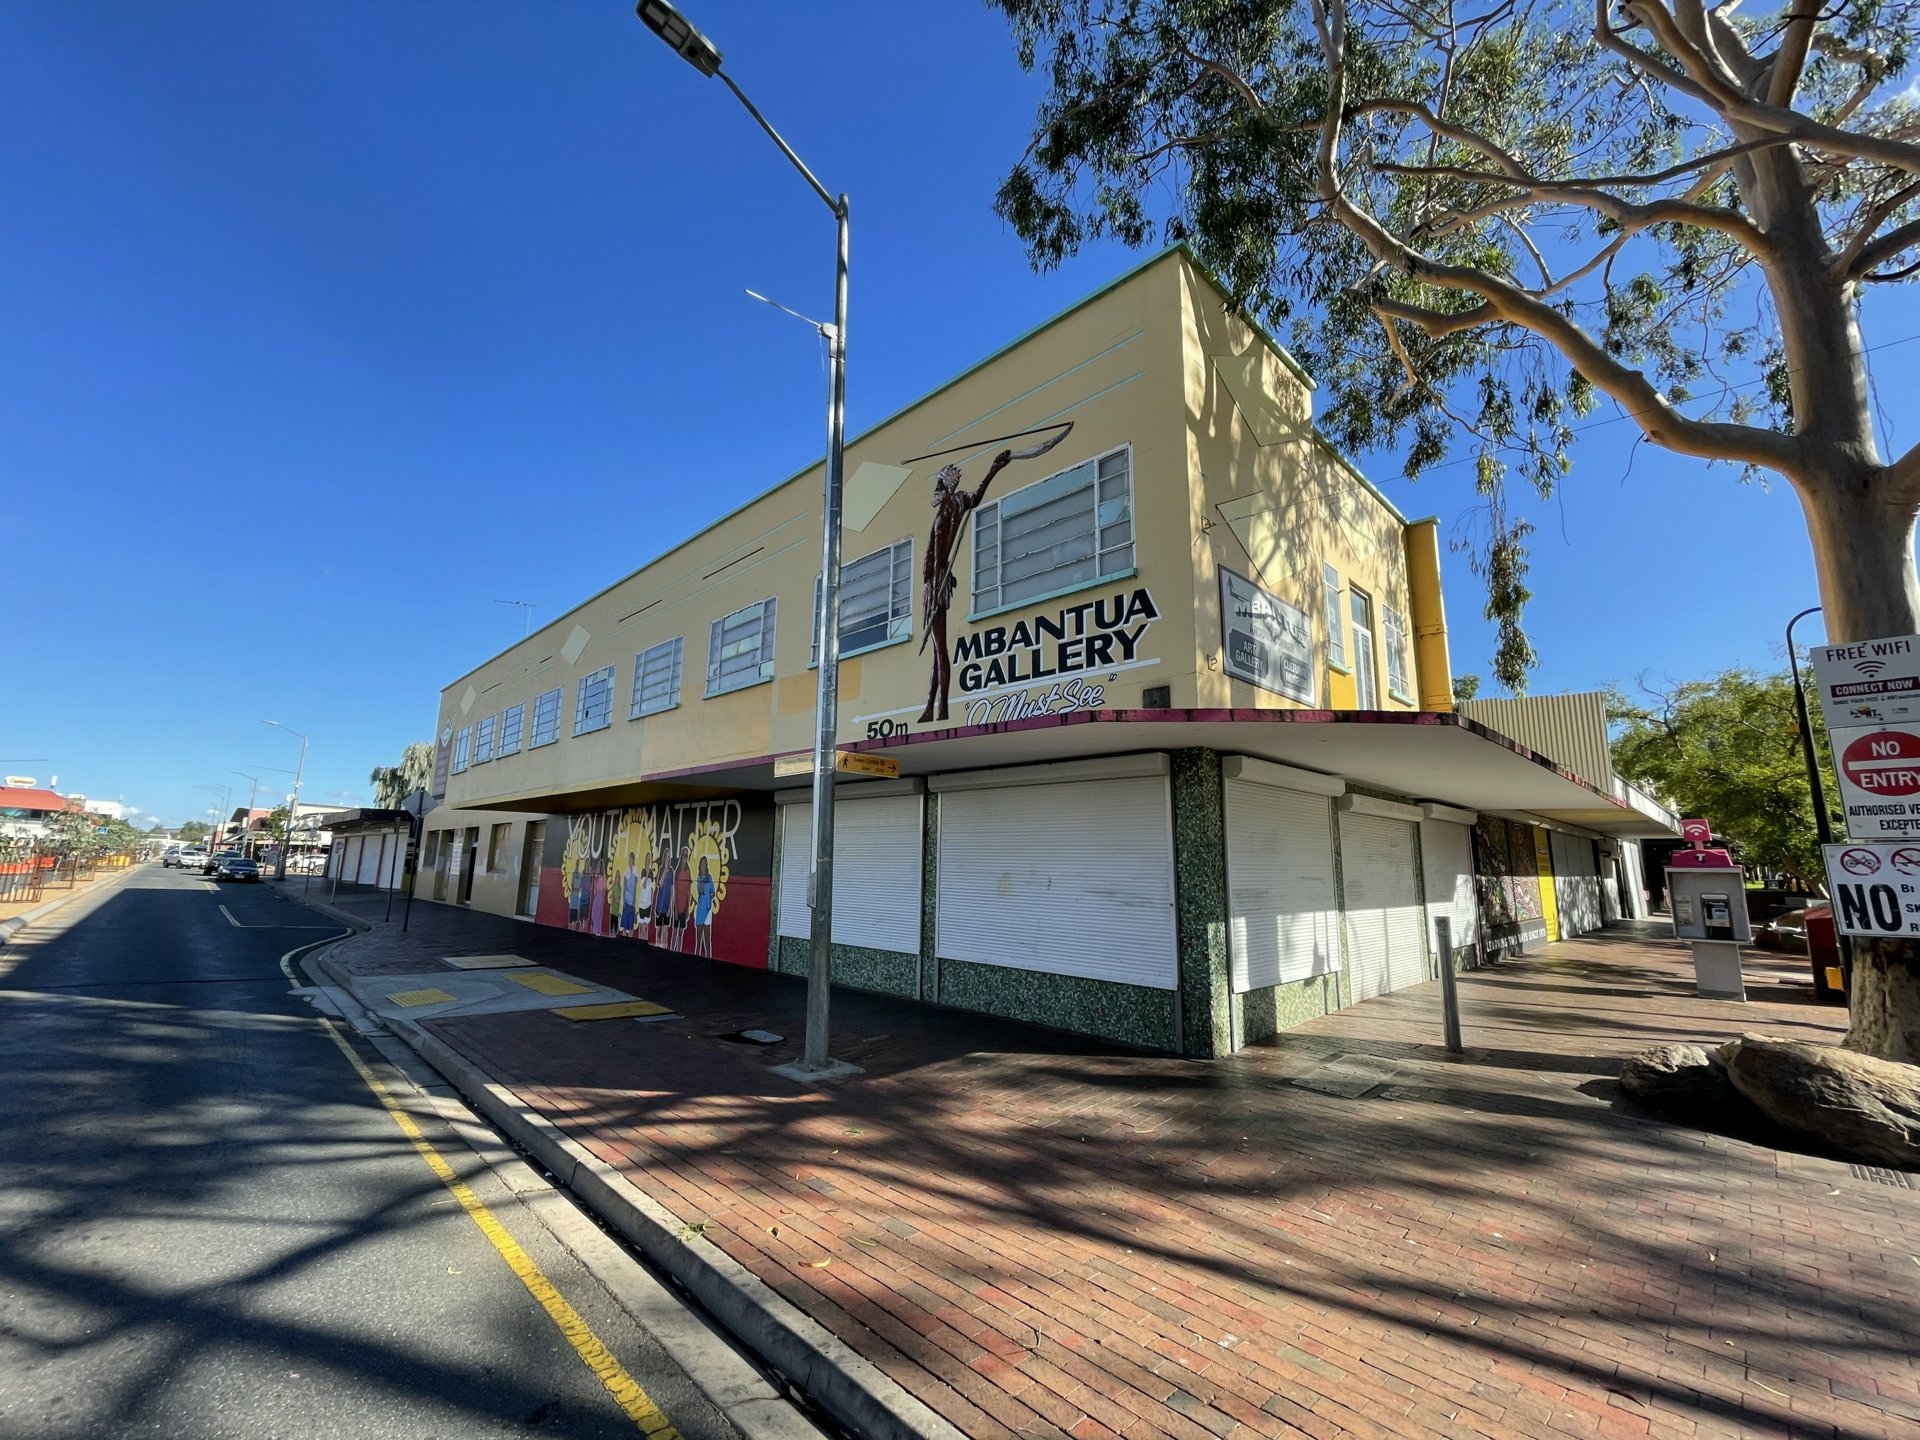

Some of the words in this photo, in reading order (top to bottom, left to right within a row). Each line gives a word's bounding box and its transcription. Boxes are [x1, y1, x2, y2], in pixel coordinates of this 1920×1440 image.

[953, 588, 1159, 664] MBANTUA
[959, 623, 1149, 692] GALLERY
[1826, 646, 1867, 662] FREE
[1871, 640, 1911, 656] WIFI
[1835, 682, 1884, 695] CONNECT
[1887, 680, 1913, 690] NOW
[992, 683, 1061, 724] Must
[866, 718, 909, 740] 50m
[1871, 741, 1901, 757] NO
[1860, 771, 1920, 788] ENTRY
[1849, 804, 1906, 816] AUTHORISED
[568, 808, 631, 860] YOUTH
[636, 800, 741, 860] MATTER
[1837, 883, 1902, 932] NO
